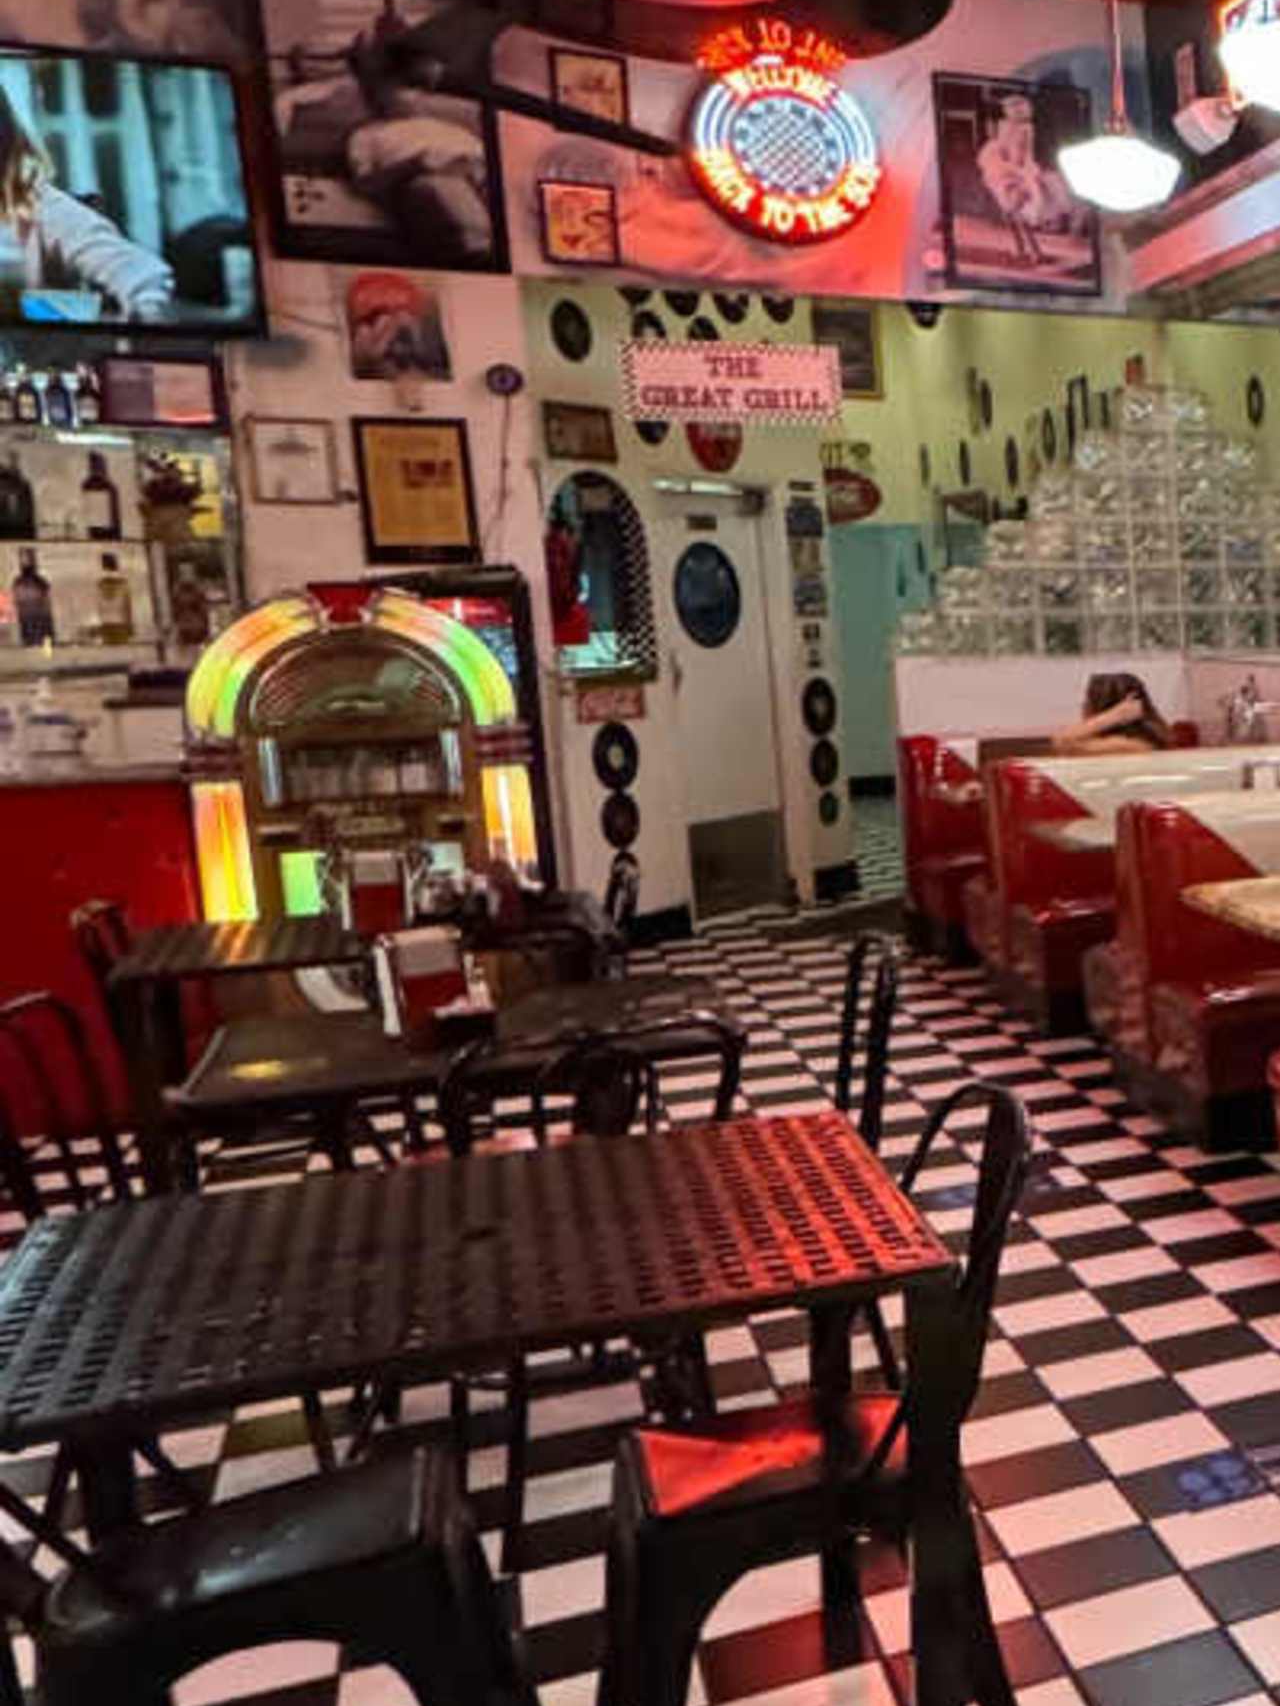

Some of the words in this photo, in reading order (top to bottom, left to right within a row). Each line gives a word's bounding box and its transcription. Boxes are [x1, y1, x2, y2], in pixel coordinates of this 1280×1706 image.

[760, 195, 795, 233] TO
[704, 355, 762, 378] THE
[639, 384, 733, 407] GREAT
[743, 387, 828, 410] GRILL
